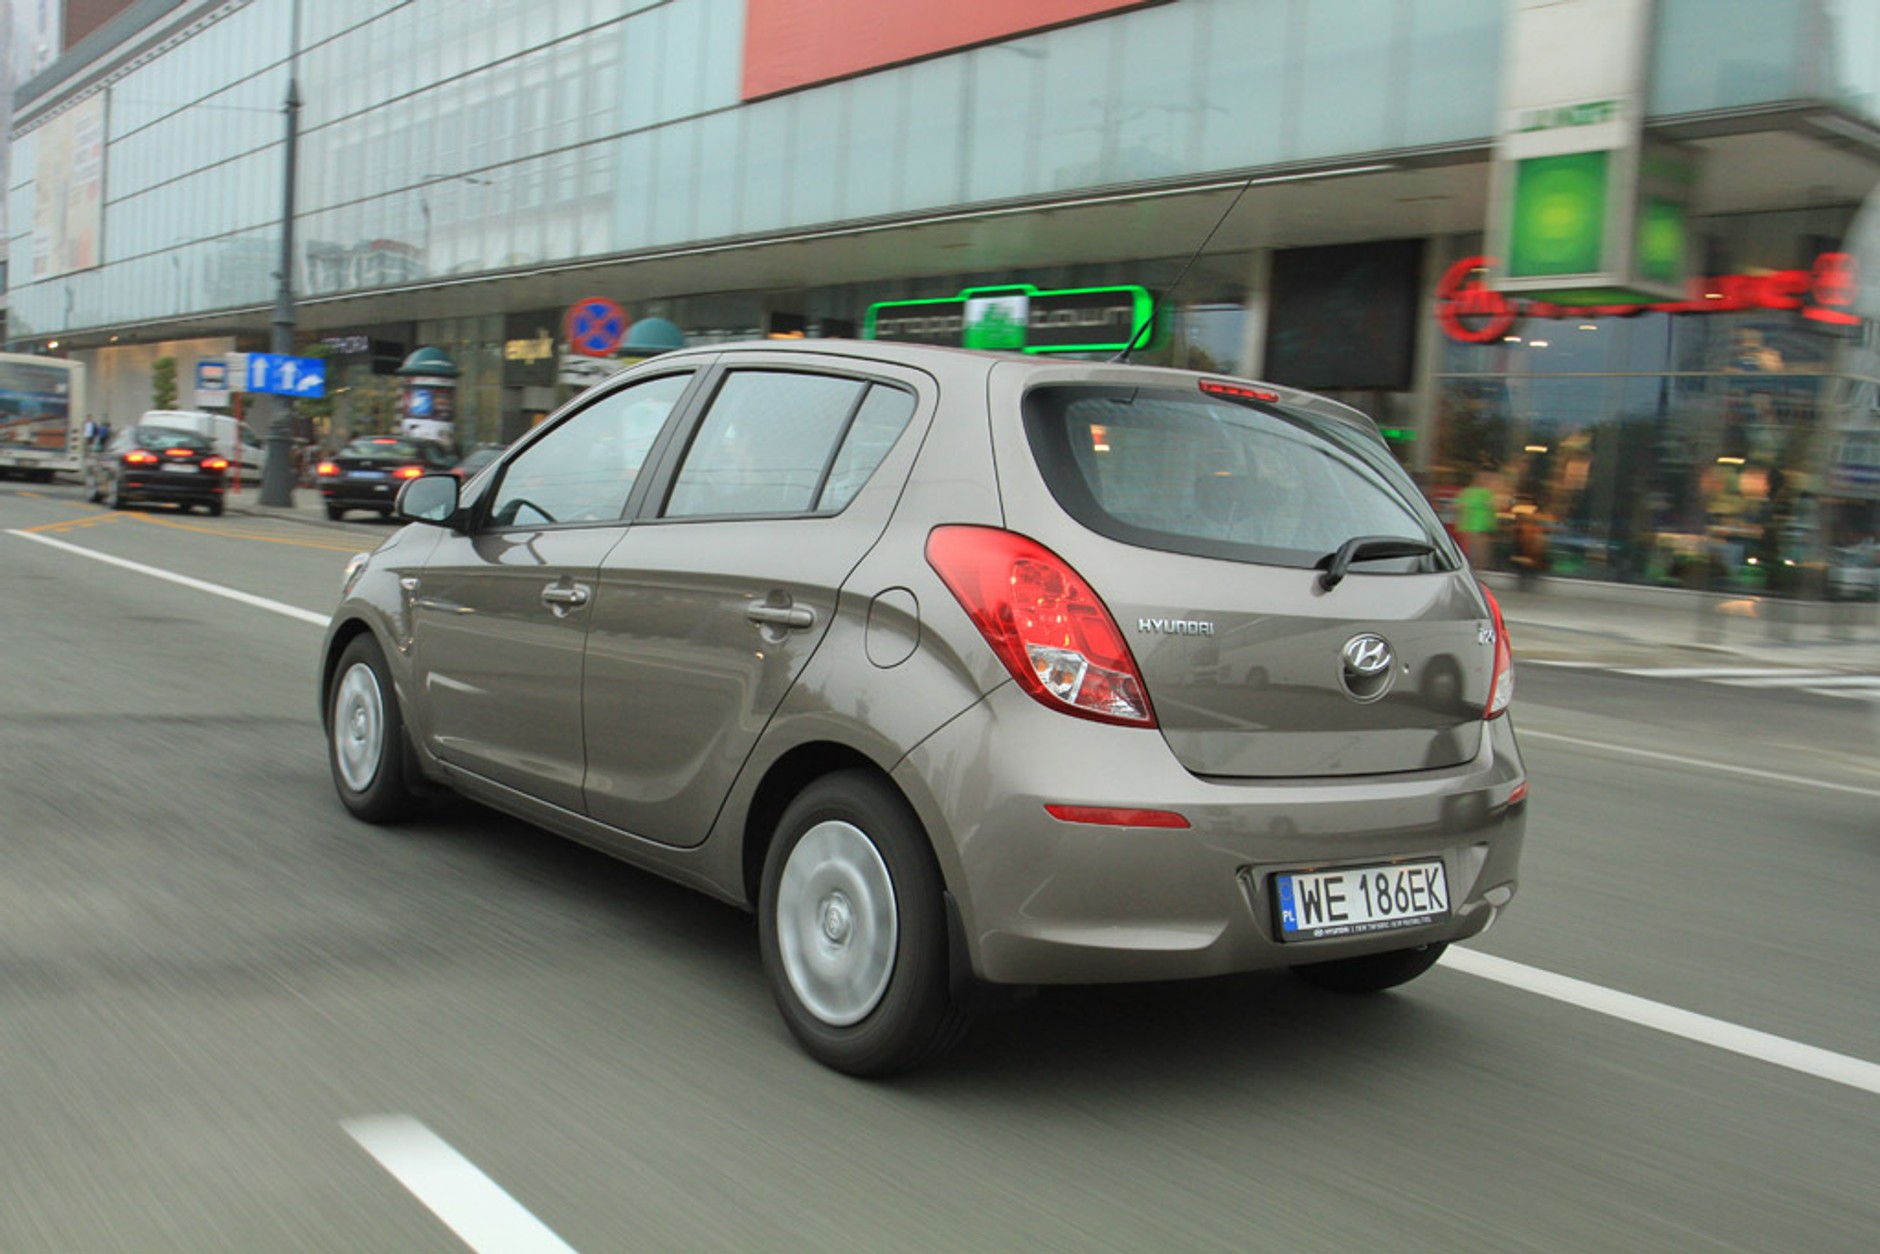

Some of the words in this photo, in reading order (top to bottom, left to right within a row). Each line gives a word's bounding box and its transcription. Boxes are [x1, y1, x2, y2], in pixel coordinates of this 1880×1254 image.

[1138, 619, 1214, 636] HYUNDAI
[1299, 876, 1348, 924] WE
[1359, 867, 1444, 918] 186EK
[1283, 910, 1295, 922] PL
